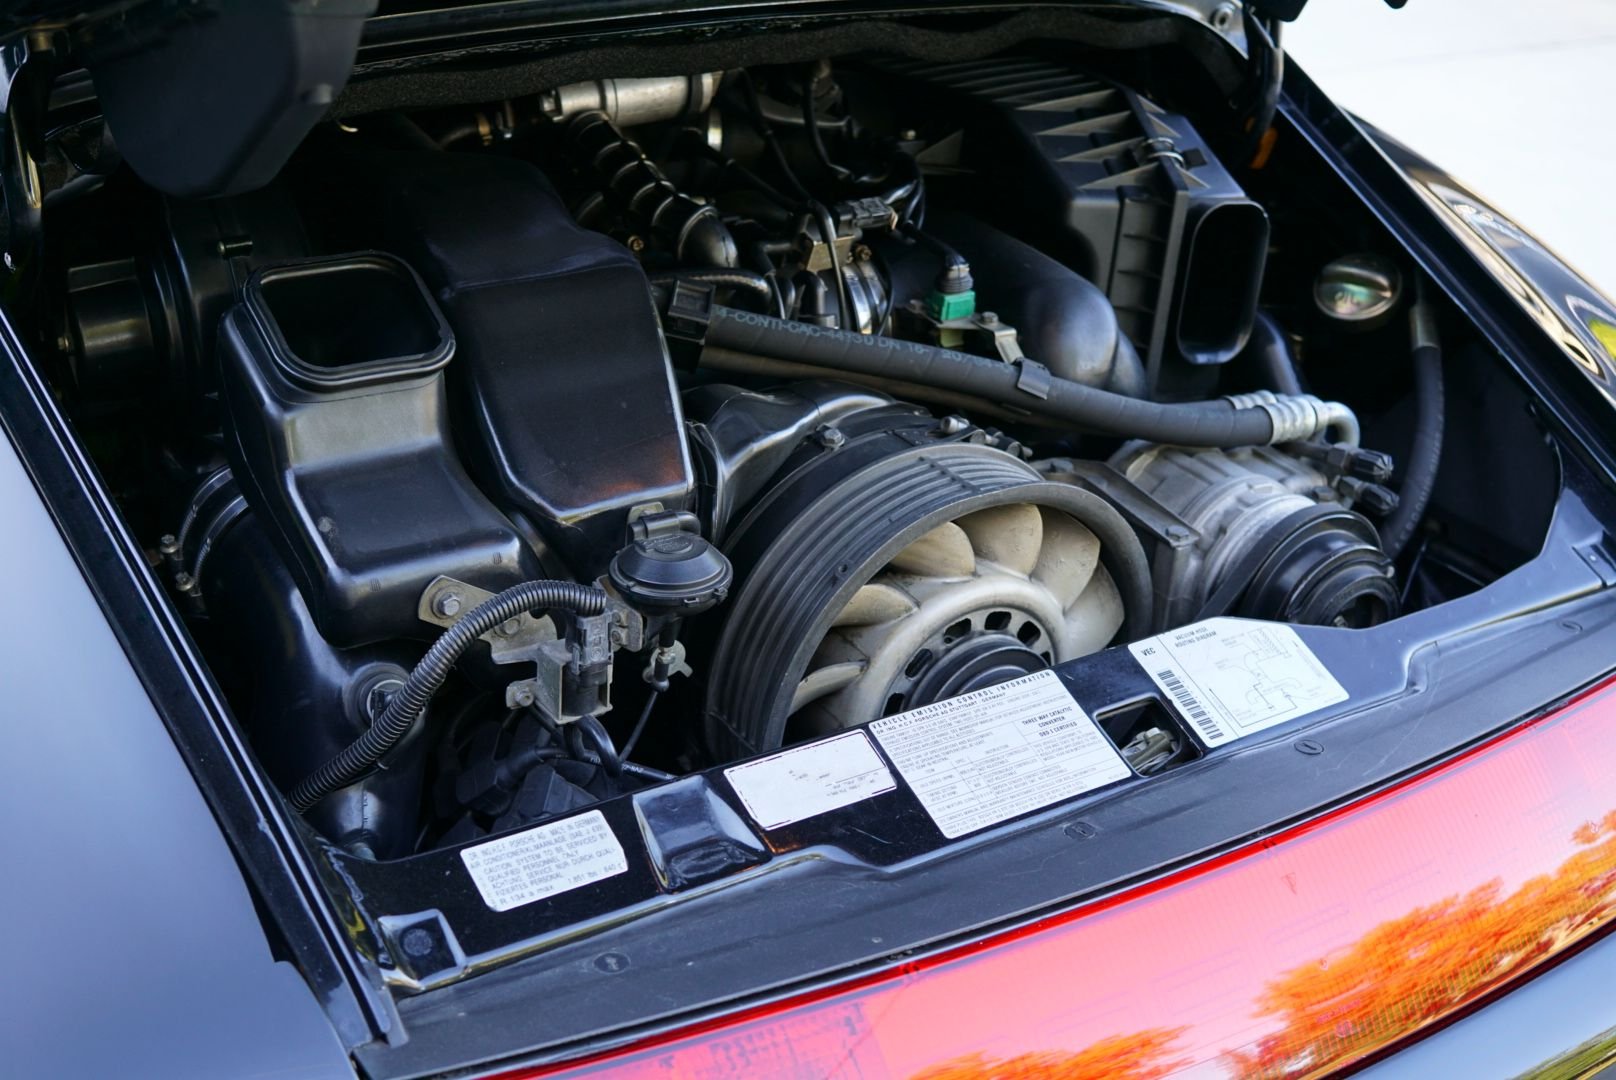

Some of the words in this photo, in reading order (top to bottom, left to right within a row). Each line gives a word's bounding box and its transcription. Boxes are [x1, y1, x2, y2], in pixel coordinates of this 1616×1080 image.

[1140, 647, 1156, 657] VEC
[871, 714, 907, 729] VEHICLE
[910, 701, 954, 717] EMISSION
[955, 689, 993, 704] CONTROL
[995, 671, 1051, 691] INFORMATION
[913, 712, 940, 723] PORSCHE
[948, 700, 978, 712] STUTTGART
[1021, 717, 1038, 725] THREE
[1048, 705, 1072, 717] CATALYTIC
[1037, 715, 1066, 727] CONVERTER
[1052, 721, 1078, 732] CERTIFIED
[514, 852, 542, 865] SYSTEM
[565, 834, 598, 850] SERVICED
[597, 831, 609, 839] BY
[486, 867, 522, 883] QUALIFIED
[521, 855, 560, 872] PERSONNEL
[561, 848, 580, 860] ONLY
[525, 865, 554, 879] SERVICE
[554, 860, 570, 870] NUR
[570, 852, 594, 865] DURCH
[494, 881, 529, 898] FIZIERTES
[528, 870, 564, 887] PERSONAL
[509, 891, 526, 902] 134
